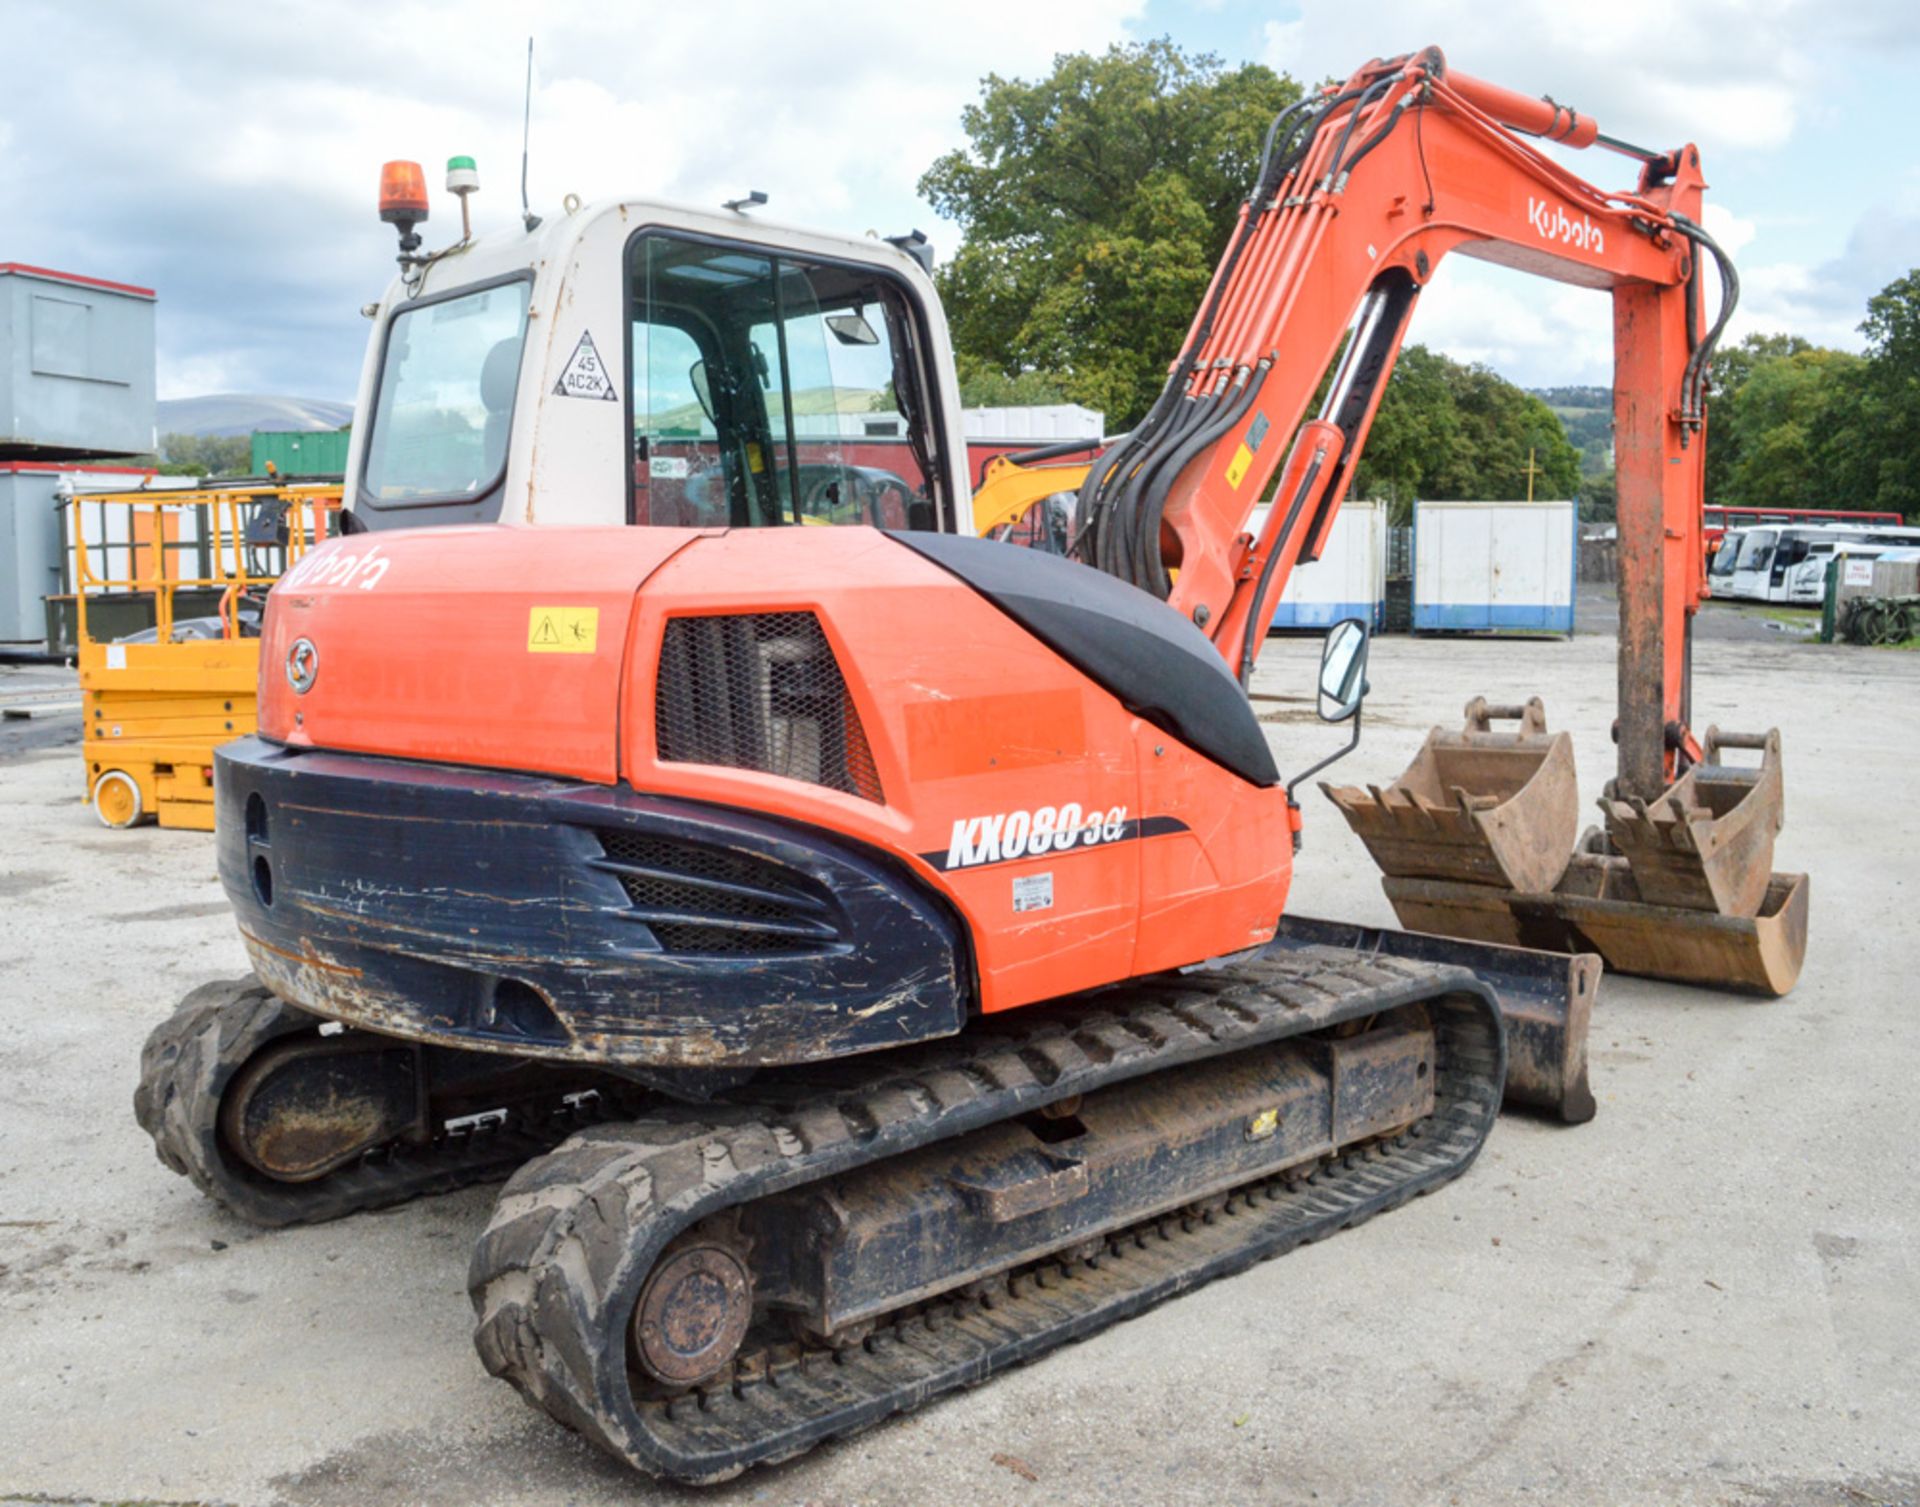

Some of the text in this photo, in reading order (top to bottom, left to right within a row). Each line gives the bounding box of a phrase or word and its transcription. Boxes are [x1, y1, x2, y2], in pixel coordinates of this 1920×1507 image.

[1528, 195, 1604, 254] Kubota
[578, 356, 595, 372] 45
[567, 373, 602, 391] AC2K
